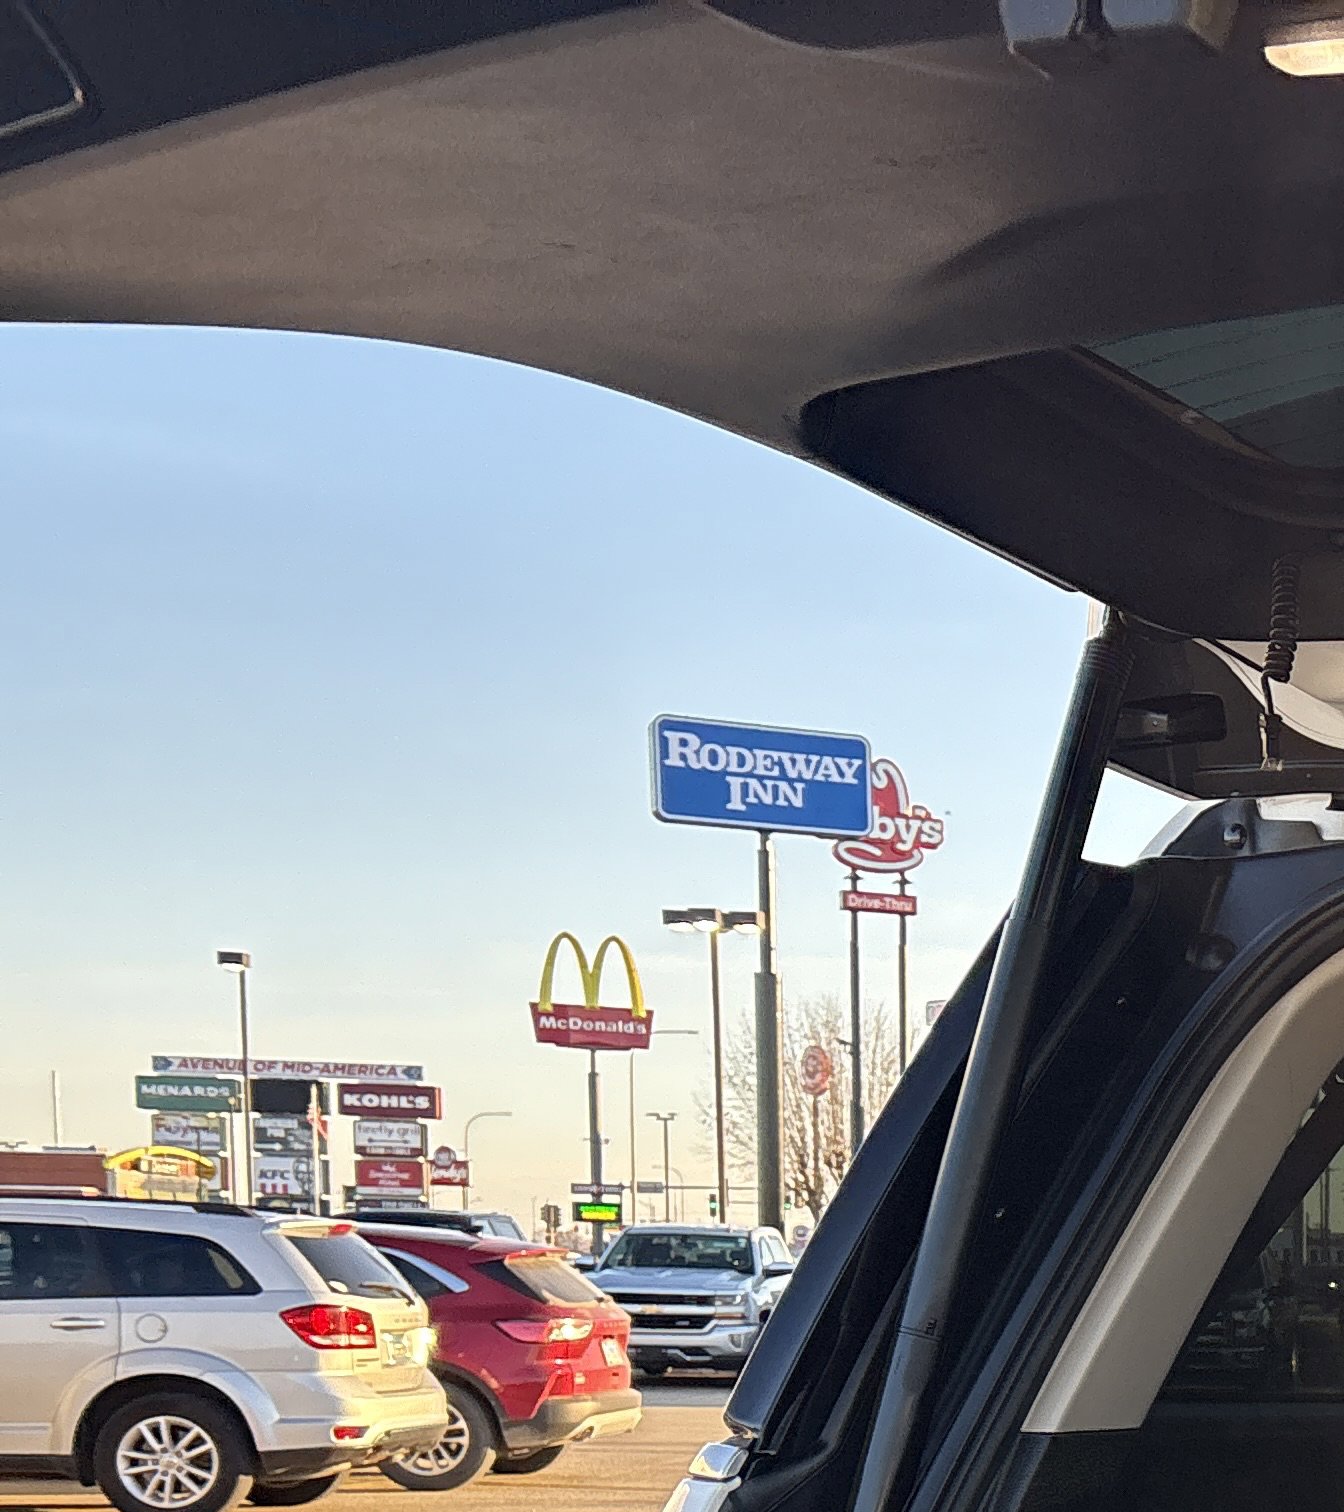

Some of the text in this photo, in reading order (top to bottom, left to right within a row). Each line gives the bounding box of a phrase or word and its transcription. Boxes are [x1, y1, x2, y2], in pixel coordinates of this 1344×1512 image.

[662, 730, 863, 785] RODEWAY
[725, 775, 806, 811] INN
[868, 804, 943, 852] by's
[847, 893, 913, 913] Drive-Thru
[539, 1014, 647, 1035] McDonald's
[253, 1062, 278, 1073] OF
[281, 1062, 399, 1077] MID-AMERICA
[140, 1083, 231, 1097] MENARDS
[342, 1092, 431, 1110] KOHL'S
[258, 1168, 291, 1181] KFC
